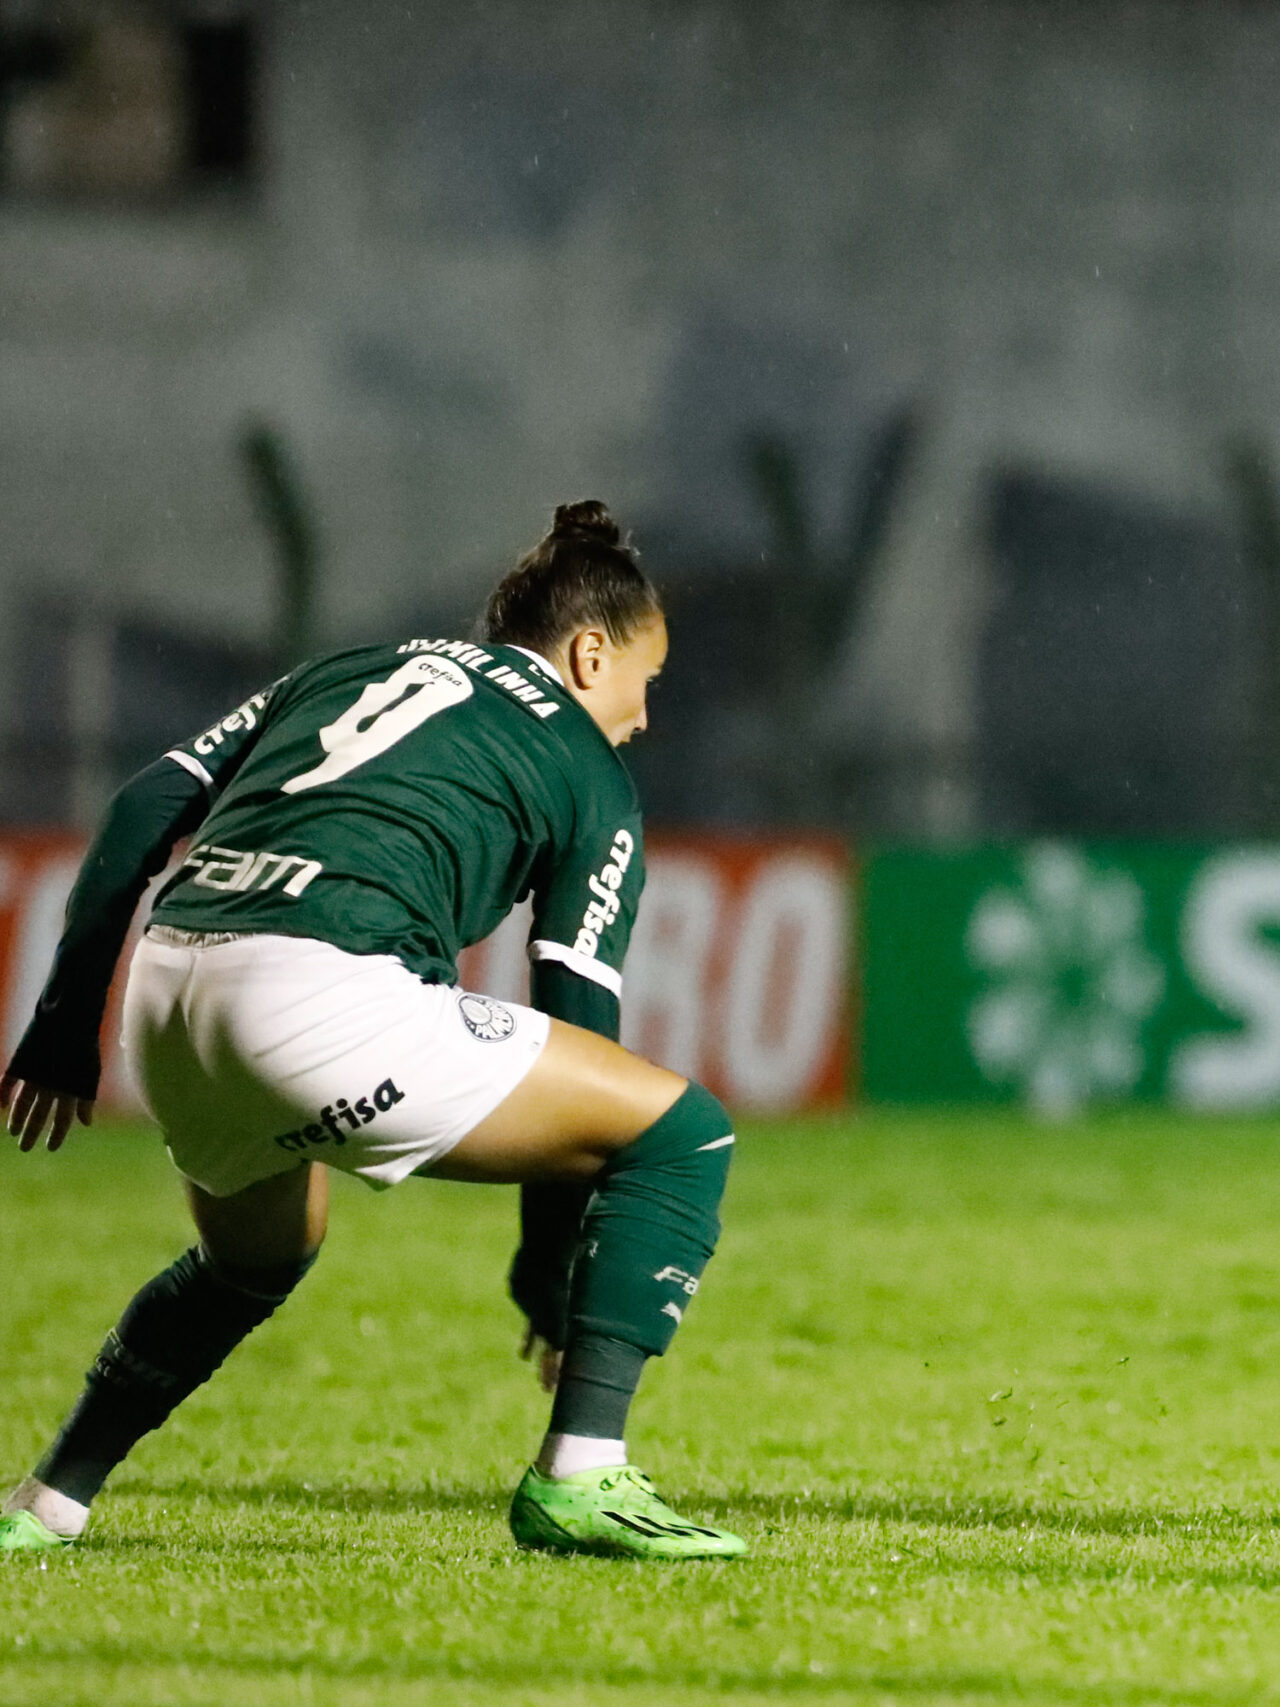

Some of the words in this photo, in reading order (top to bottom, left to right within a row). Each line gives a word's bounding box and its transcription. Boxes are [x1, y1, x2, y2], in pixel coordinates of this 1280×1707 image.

[418, 662, 462, 687] crefisa
[573, 828, 634, 959] crefisa
[274, 1077, 406, 1151] crefisa
